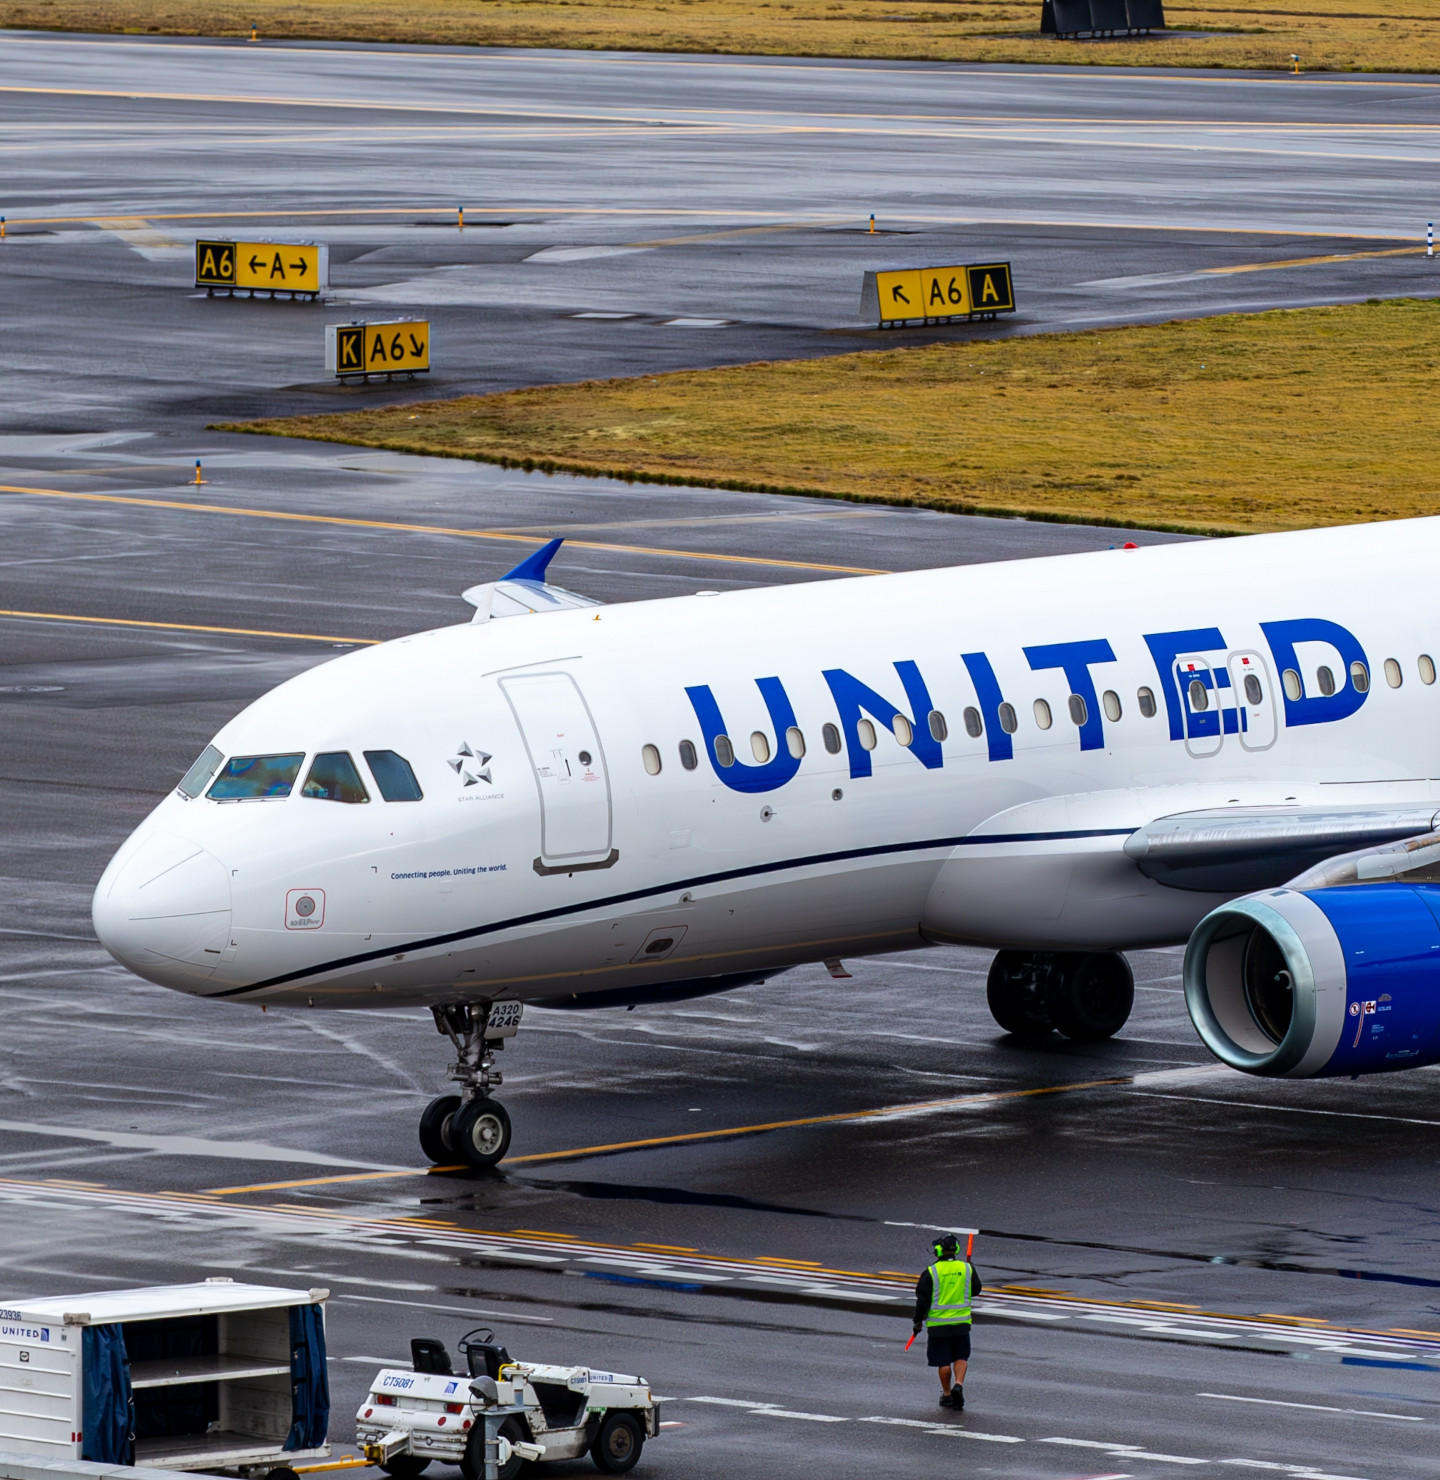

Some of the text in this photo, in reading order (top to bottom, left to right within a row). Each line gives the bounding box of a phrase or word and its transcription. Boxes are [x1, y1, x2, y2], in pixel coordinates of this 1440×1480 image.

[201, 248, 286, 280] A6 A
[929, 273, 999, 306] A6 A
[342, 332, 405, 365] K A6
[684, 618, 1369, 794] UNITED
[457, 793, 505, 803] STAR ALLIANCE
[391, 863, 508, 880] Connecting people. Uniting the world.
[492, 1004, 520, 1016] A320
[488, 1015, 520, 1028] 4246
[2, 1326, 39, 1338] UNITED
[383, 1375, 415, 1389] CT5081
